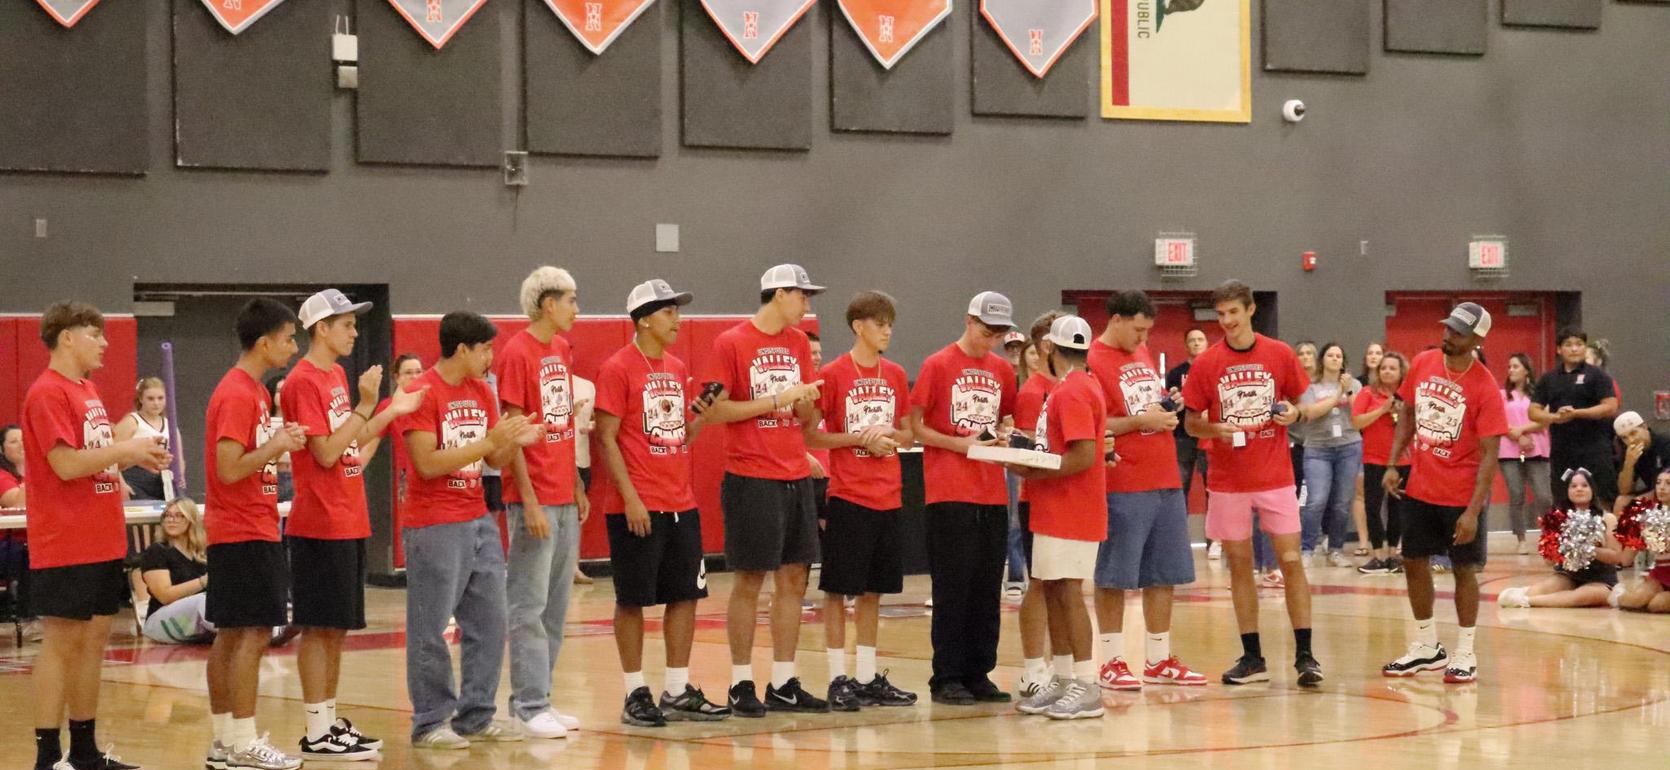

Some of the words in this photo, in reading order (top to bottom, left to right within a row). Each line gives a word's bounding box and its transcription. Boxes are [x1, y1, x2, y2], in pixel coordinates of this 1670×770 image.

[1137, 0, 1150, 39] UBLIC
[1168, 242, 1187, 262] EXIT
[1481, 245, 1499, 265] EXIT
[752, 354, 798, 374] VALLEY
[755, 384, 768, 394] 24
[956, 375, 1001, 396] VALLEY
[1220, 371, 1273, 391] VALLEY
[848, 385, 895, 405] VALLEY
[1420, 381, 1467, 410] VALLEY
[956, 401, 968, 411] 24
